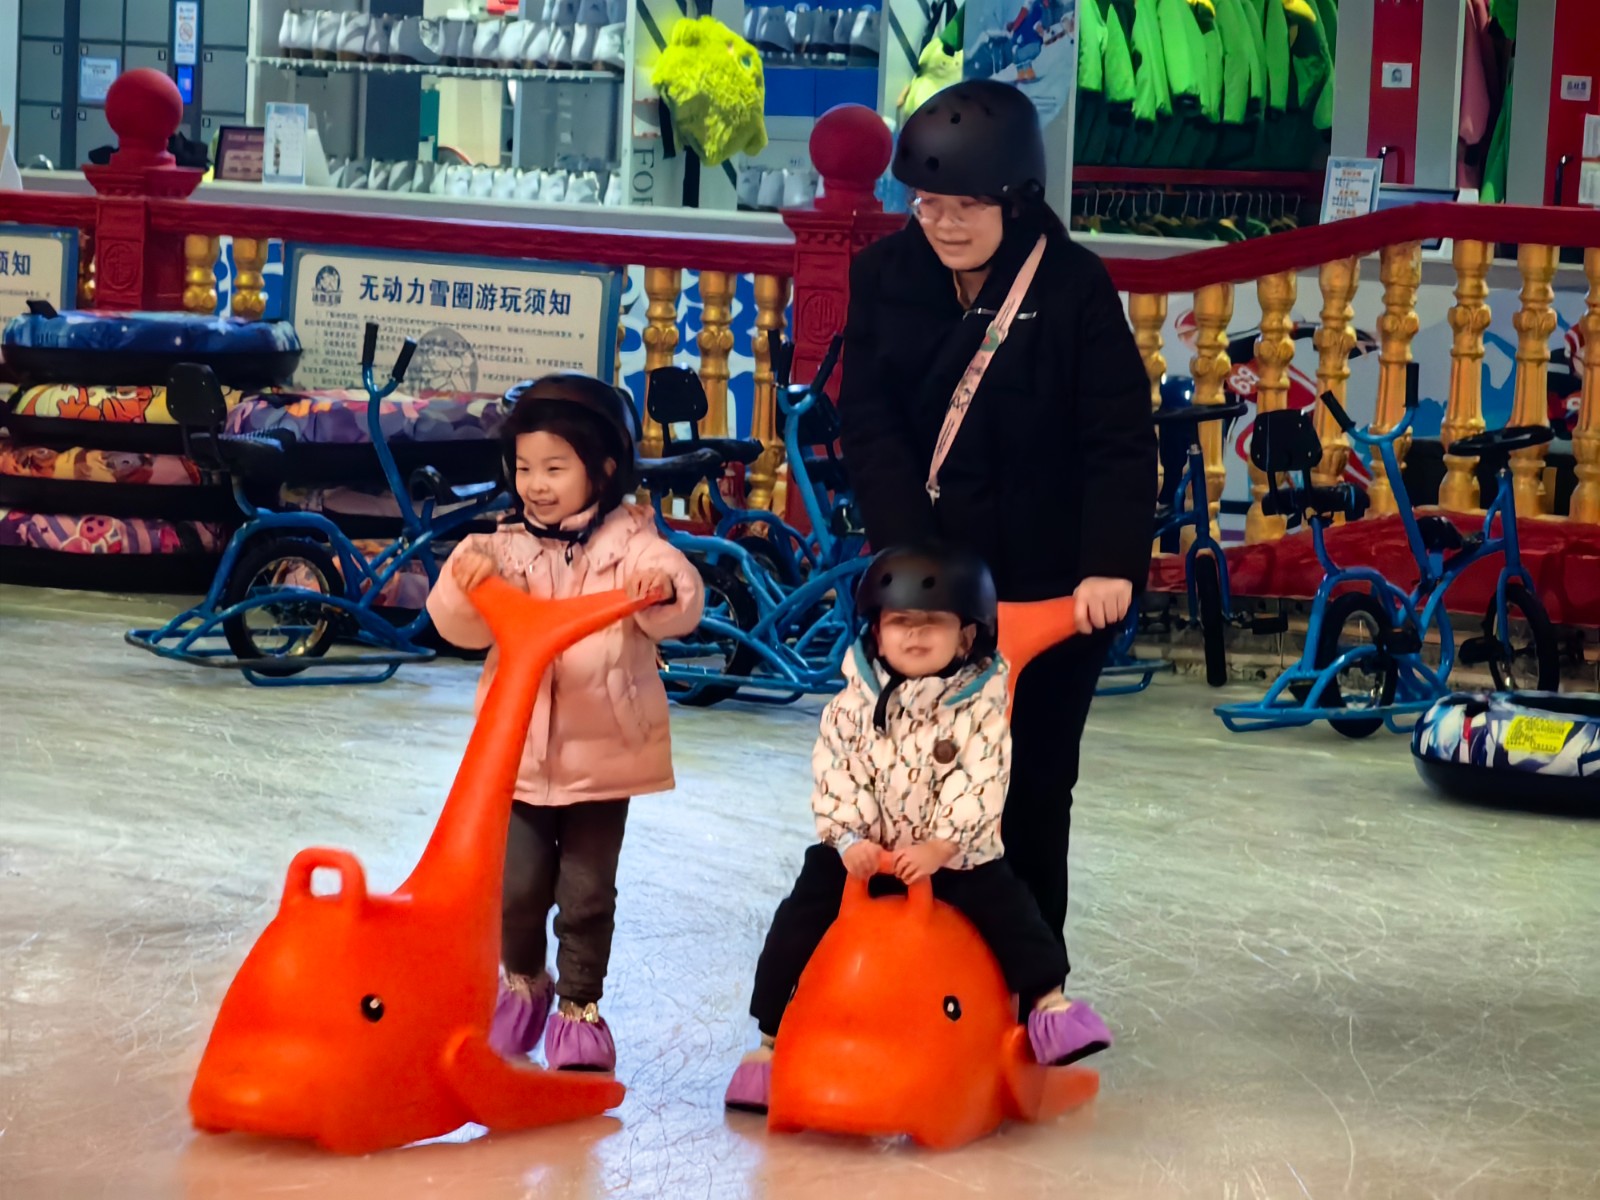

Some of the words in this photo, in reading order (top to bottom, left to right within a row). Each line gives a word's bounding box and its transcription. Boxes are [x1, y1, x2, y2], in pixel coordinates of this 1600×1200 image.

[359, 274, 571, 315] 无动力雪圈游玩须知
